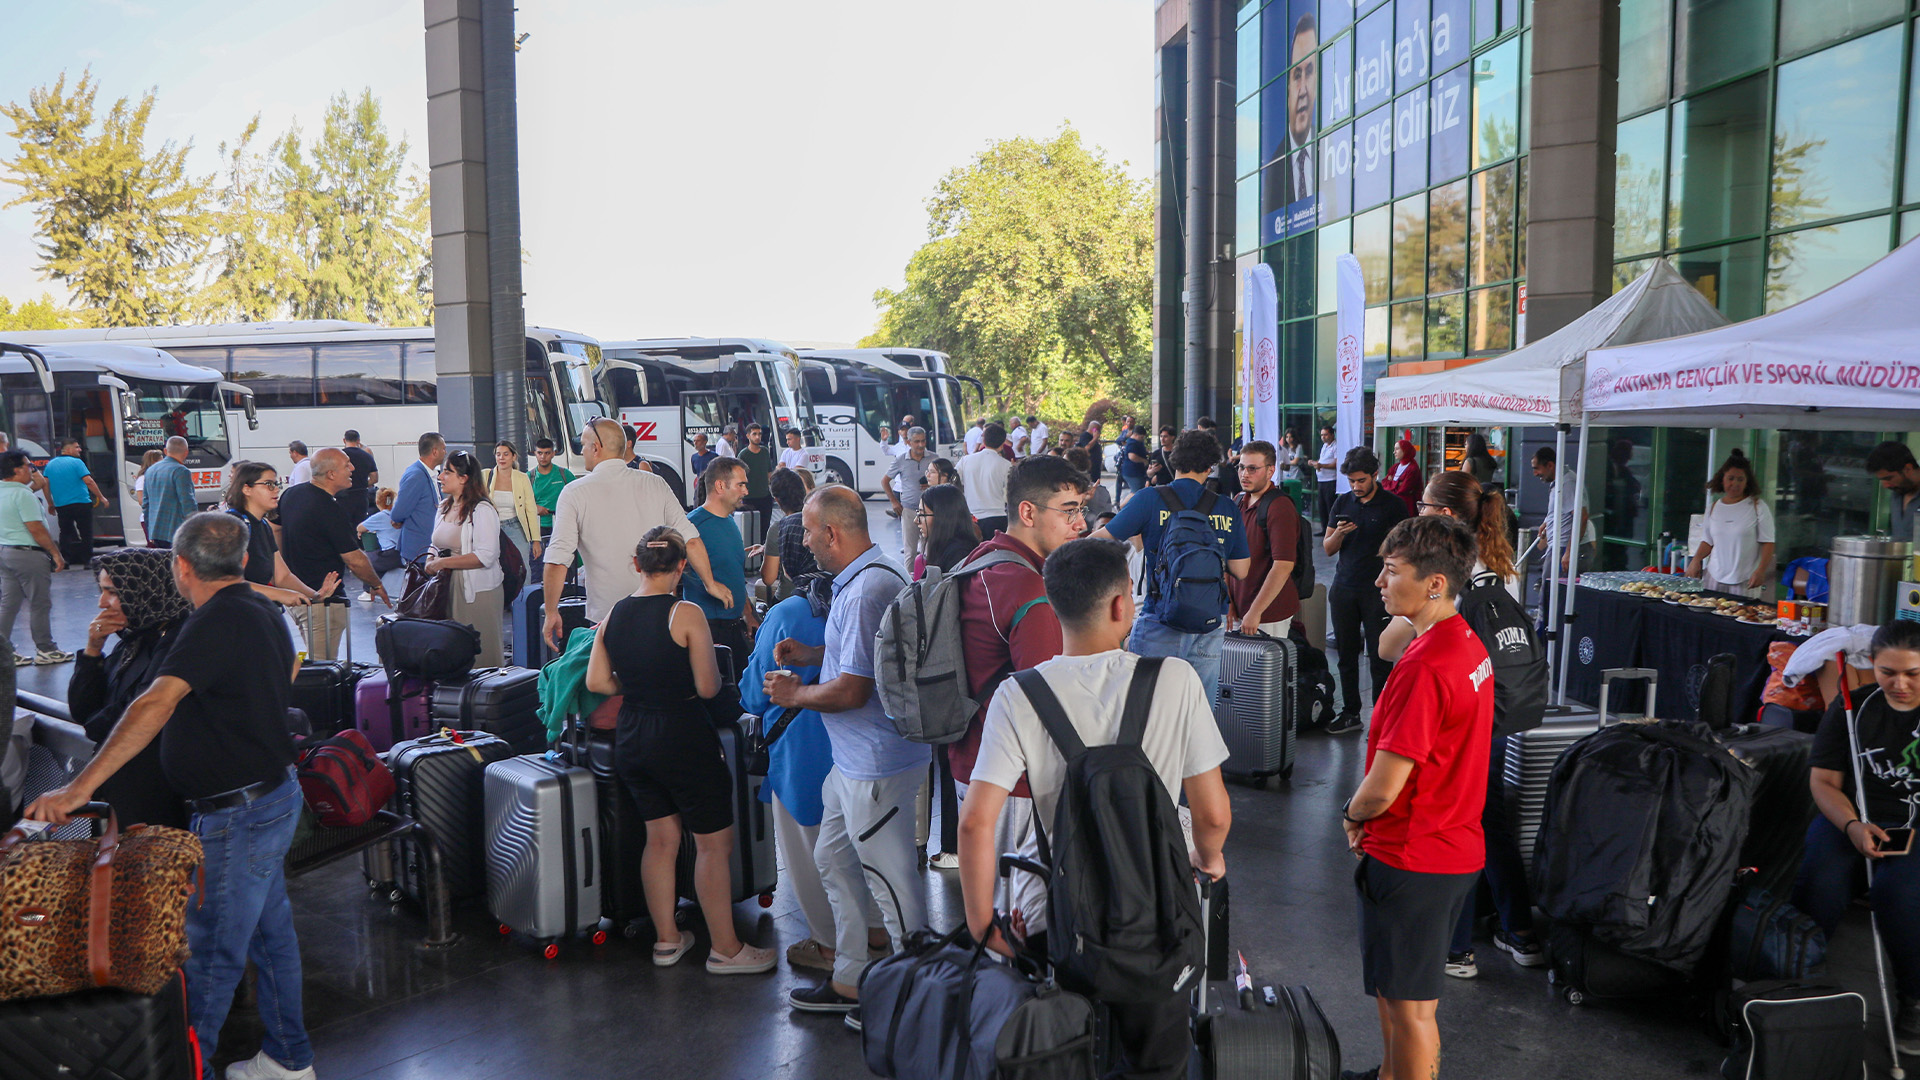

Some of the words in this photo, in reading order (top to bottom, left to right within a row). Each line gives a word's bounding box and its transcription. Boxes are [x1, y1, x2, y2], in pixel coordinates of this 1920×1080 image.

[1330, 12, 1450, 120] Antalya'ya
[1365, 79, 1460, 172] geldiniz
[1614, 372, 1672, 393] ANTALYA
[1676, 361, 1738, 392] GENÇLİK
[1743, 363, 1762, 384] VE
[1836, 360, 1920, 388] MÜDÜR
[1391, 396, 1418, 412] ANTALYA
[1419, 390, 1447, 412] GENÇLİK
[1448, 392, 1459, 408] VE
[1488, 393, 1551, 413] MÜDÜRLÜĞÜ
[1495, 626, 1529, 651] PUMA
